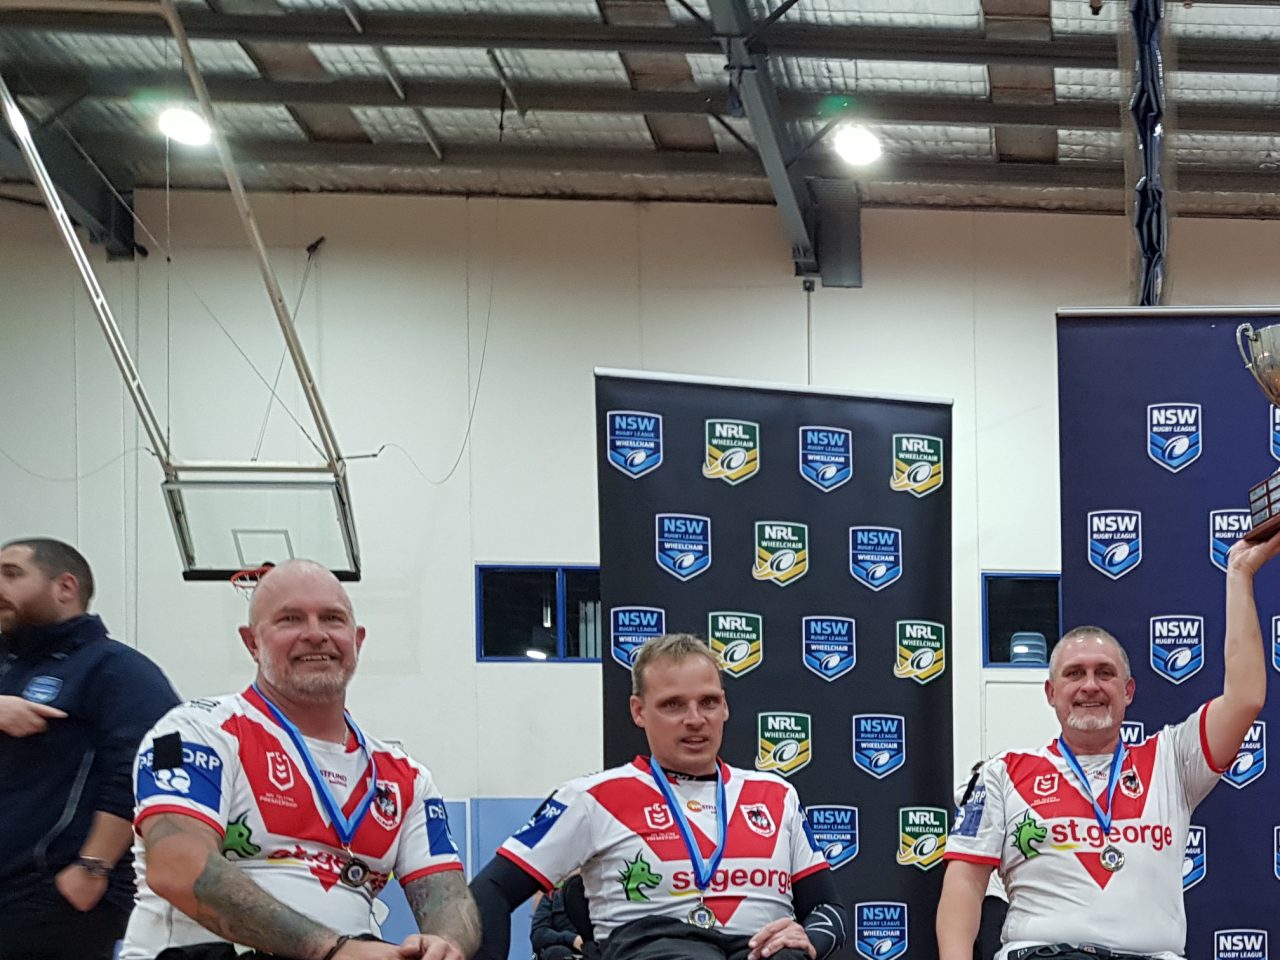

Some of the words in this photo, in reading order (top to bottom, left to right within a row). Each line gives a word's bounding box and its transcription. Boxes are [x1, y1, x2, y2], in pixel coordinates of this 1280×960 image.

[615, 416, 654, 430] NSW
[1152, 409, 1197, 424] NSW
[715, 424, 749, 439] NRL
[615, 439, 654, 447] WHEELCHAIR
[712, 438, 753, 447] WHEELCHAIR
[807, 431, 844, 446] NSW
[902, 438, 934, 453] NRL
[807, 455, 844, 464] WHEELCHAIR
[899, 452, 938, 461] WHEELCHAIR
[664, 519, 703, 533] NSW
[1093, 517, 1137, 531] NSW
[765, 526, 798, 540] NRL
[857, 531, 894, 544] NSW
[664, 544, 703, 552] WHEELCHAIR
[761, 539, 802, 549] WHEELCHAIR
[857, 553, 894, 561] WHEELCHAIR
[618, 612, 657, 626] NSW
[719, 617, 752, 630] NRL
[715, 630, 756, 639] WHEELCHAIR
[811, 621, 848, 635] NSW
[906, 625, 936, 639] NRL
[1155, 621, 1199, 636] NSW
[811, 645, 848, 653] WHEELCHAIR
[903, 639, 940, 647] WHEELCHAIR
[768, 717, 801, 731] NRL
[861, 720, 897, 732] NSW
[764, 731, 805, 739] WHEELCHAIR
[814, 811, 851, 823] NSW
[909, 812, 939, 825] NRL
[1051, 819, 1172, 851] st.george
[863, 907, 900, 919] NSW
[1220, 935, 1263, 950] NSW
